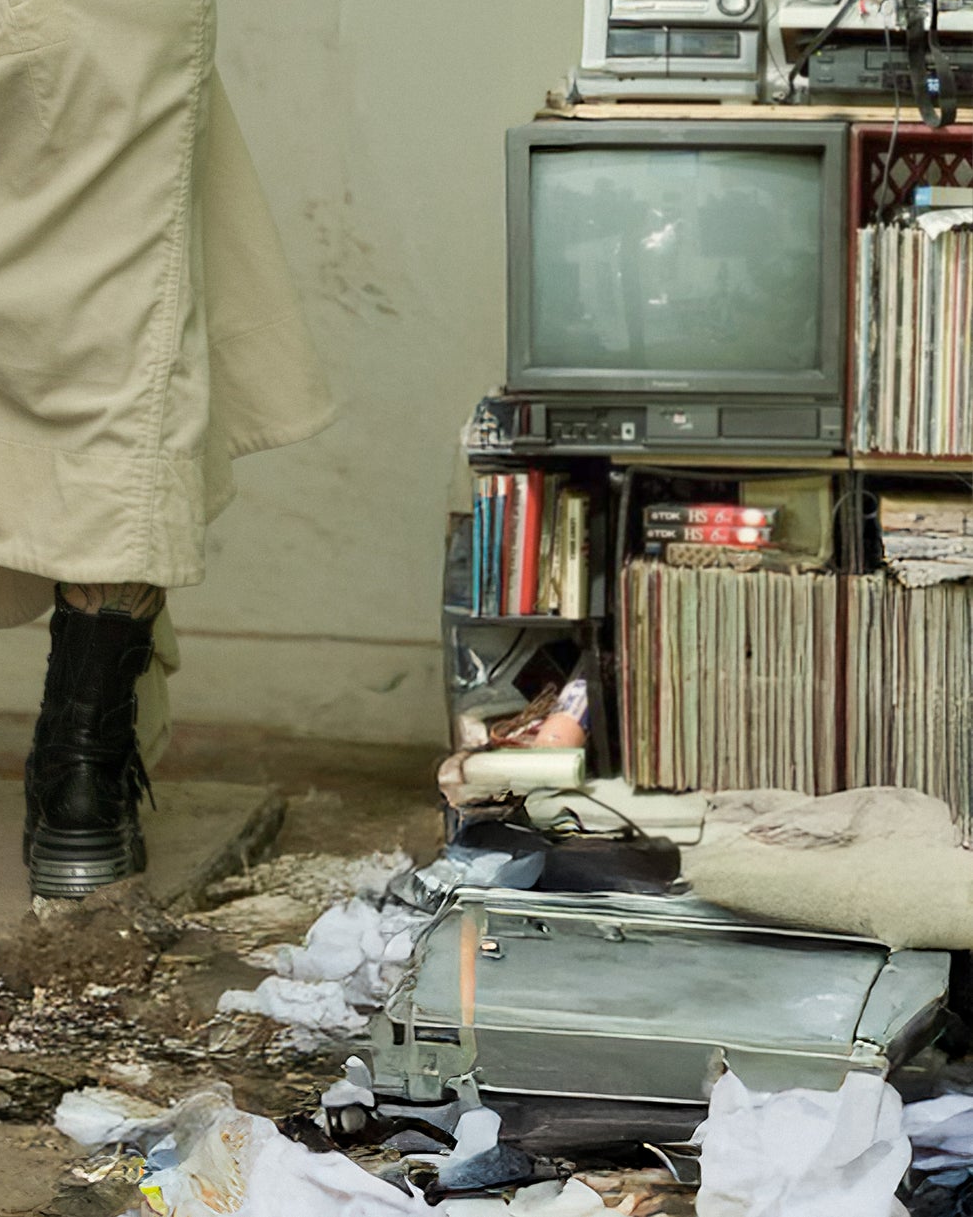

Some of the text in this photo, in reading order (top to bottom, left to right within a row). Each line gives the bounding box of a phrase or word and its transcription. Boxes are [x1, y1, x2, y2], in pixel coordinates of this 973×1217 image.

[658, 511, 681, 521] TDK
[689, 508, 708, 524] HS
[654, 529, 677, 539] TDK
[684, 527, 704, 541] HS
